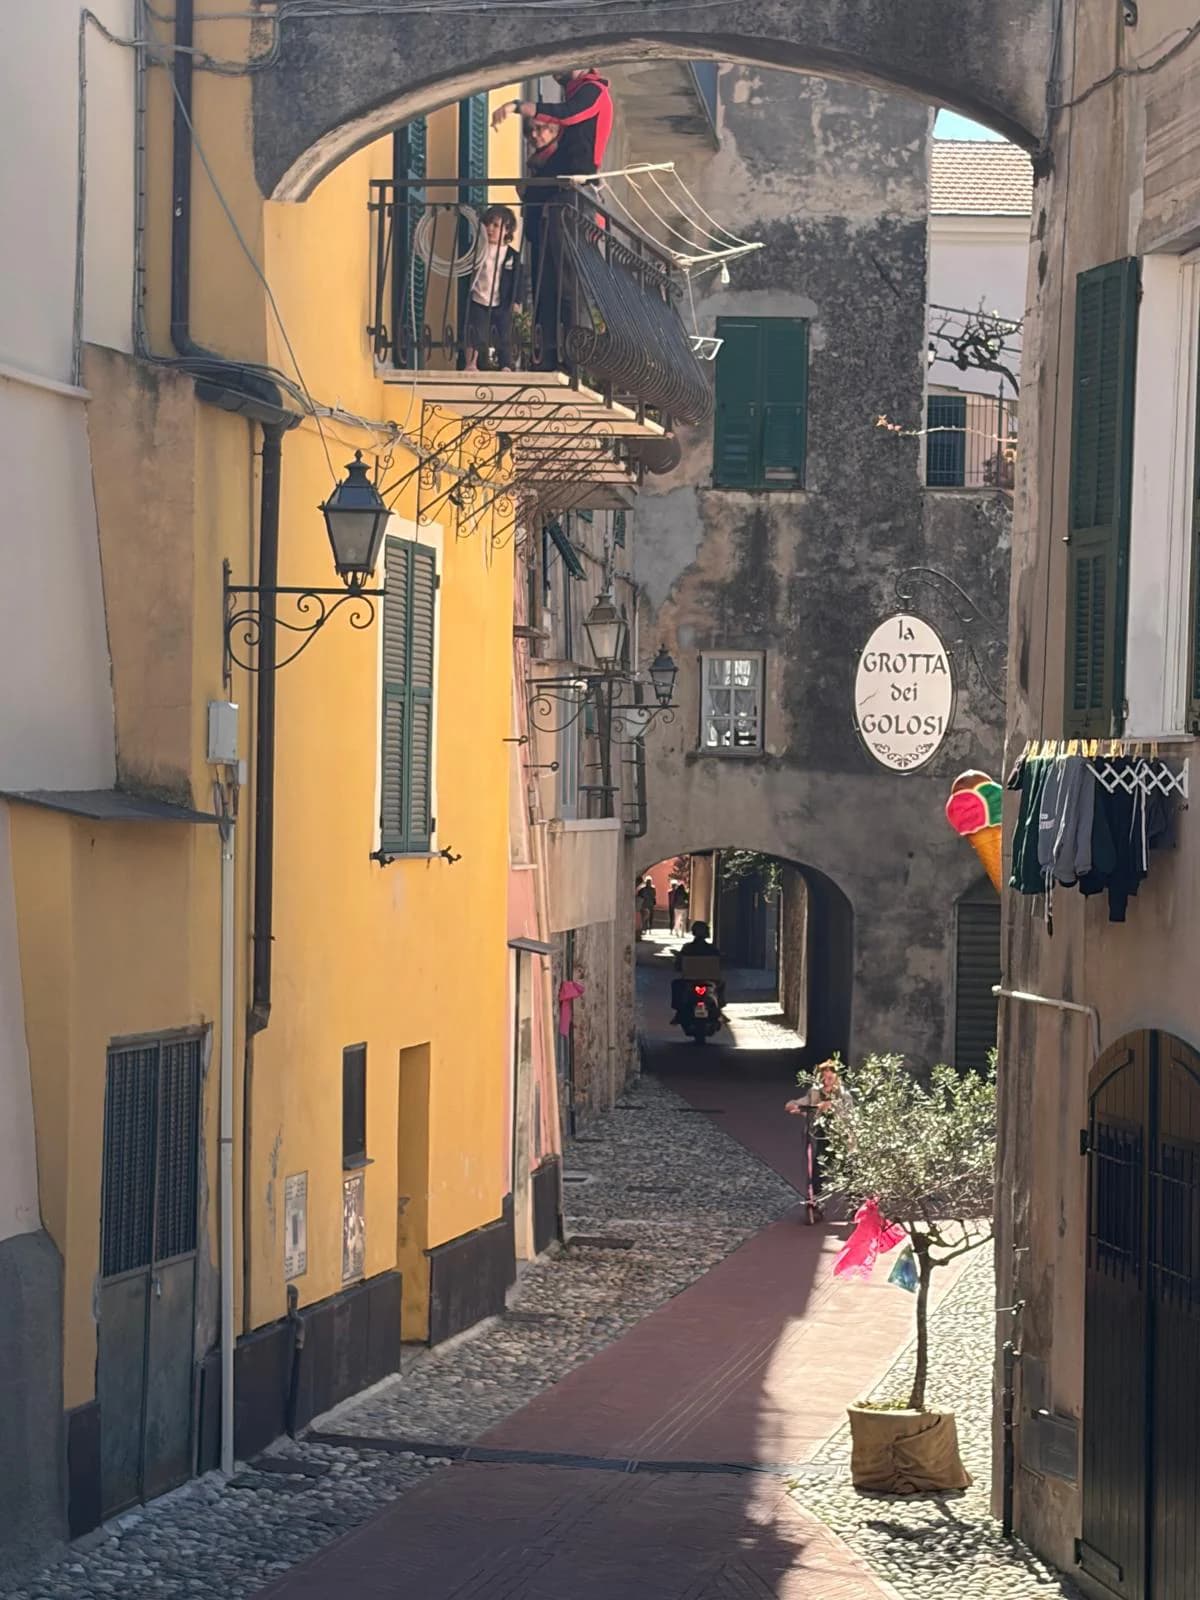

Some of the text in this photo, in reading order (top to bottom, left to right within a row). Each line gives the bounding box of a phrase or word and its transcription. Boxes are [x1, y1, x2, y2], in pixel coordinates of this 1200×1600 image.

[897, 619, 915, 641] la
[863, 652, 948, 675] GROTTA
[890, 682, 918, 702] dei
[861, 714, 944, 736] GOLOSI
